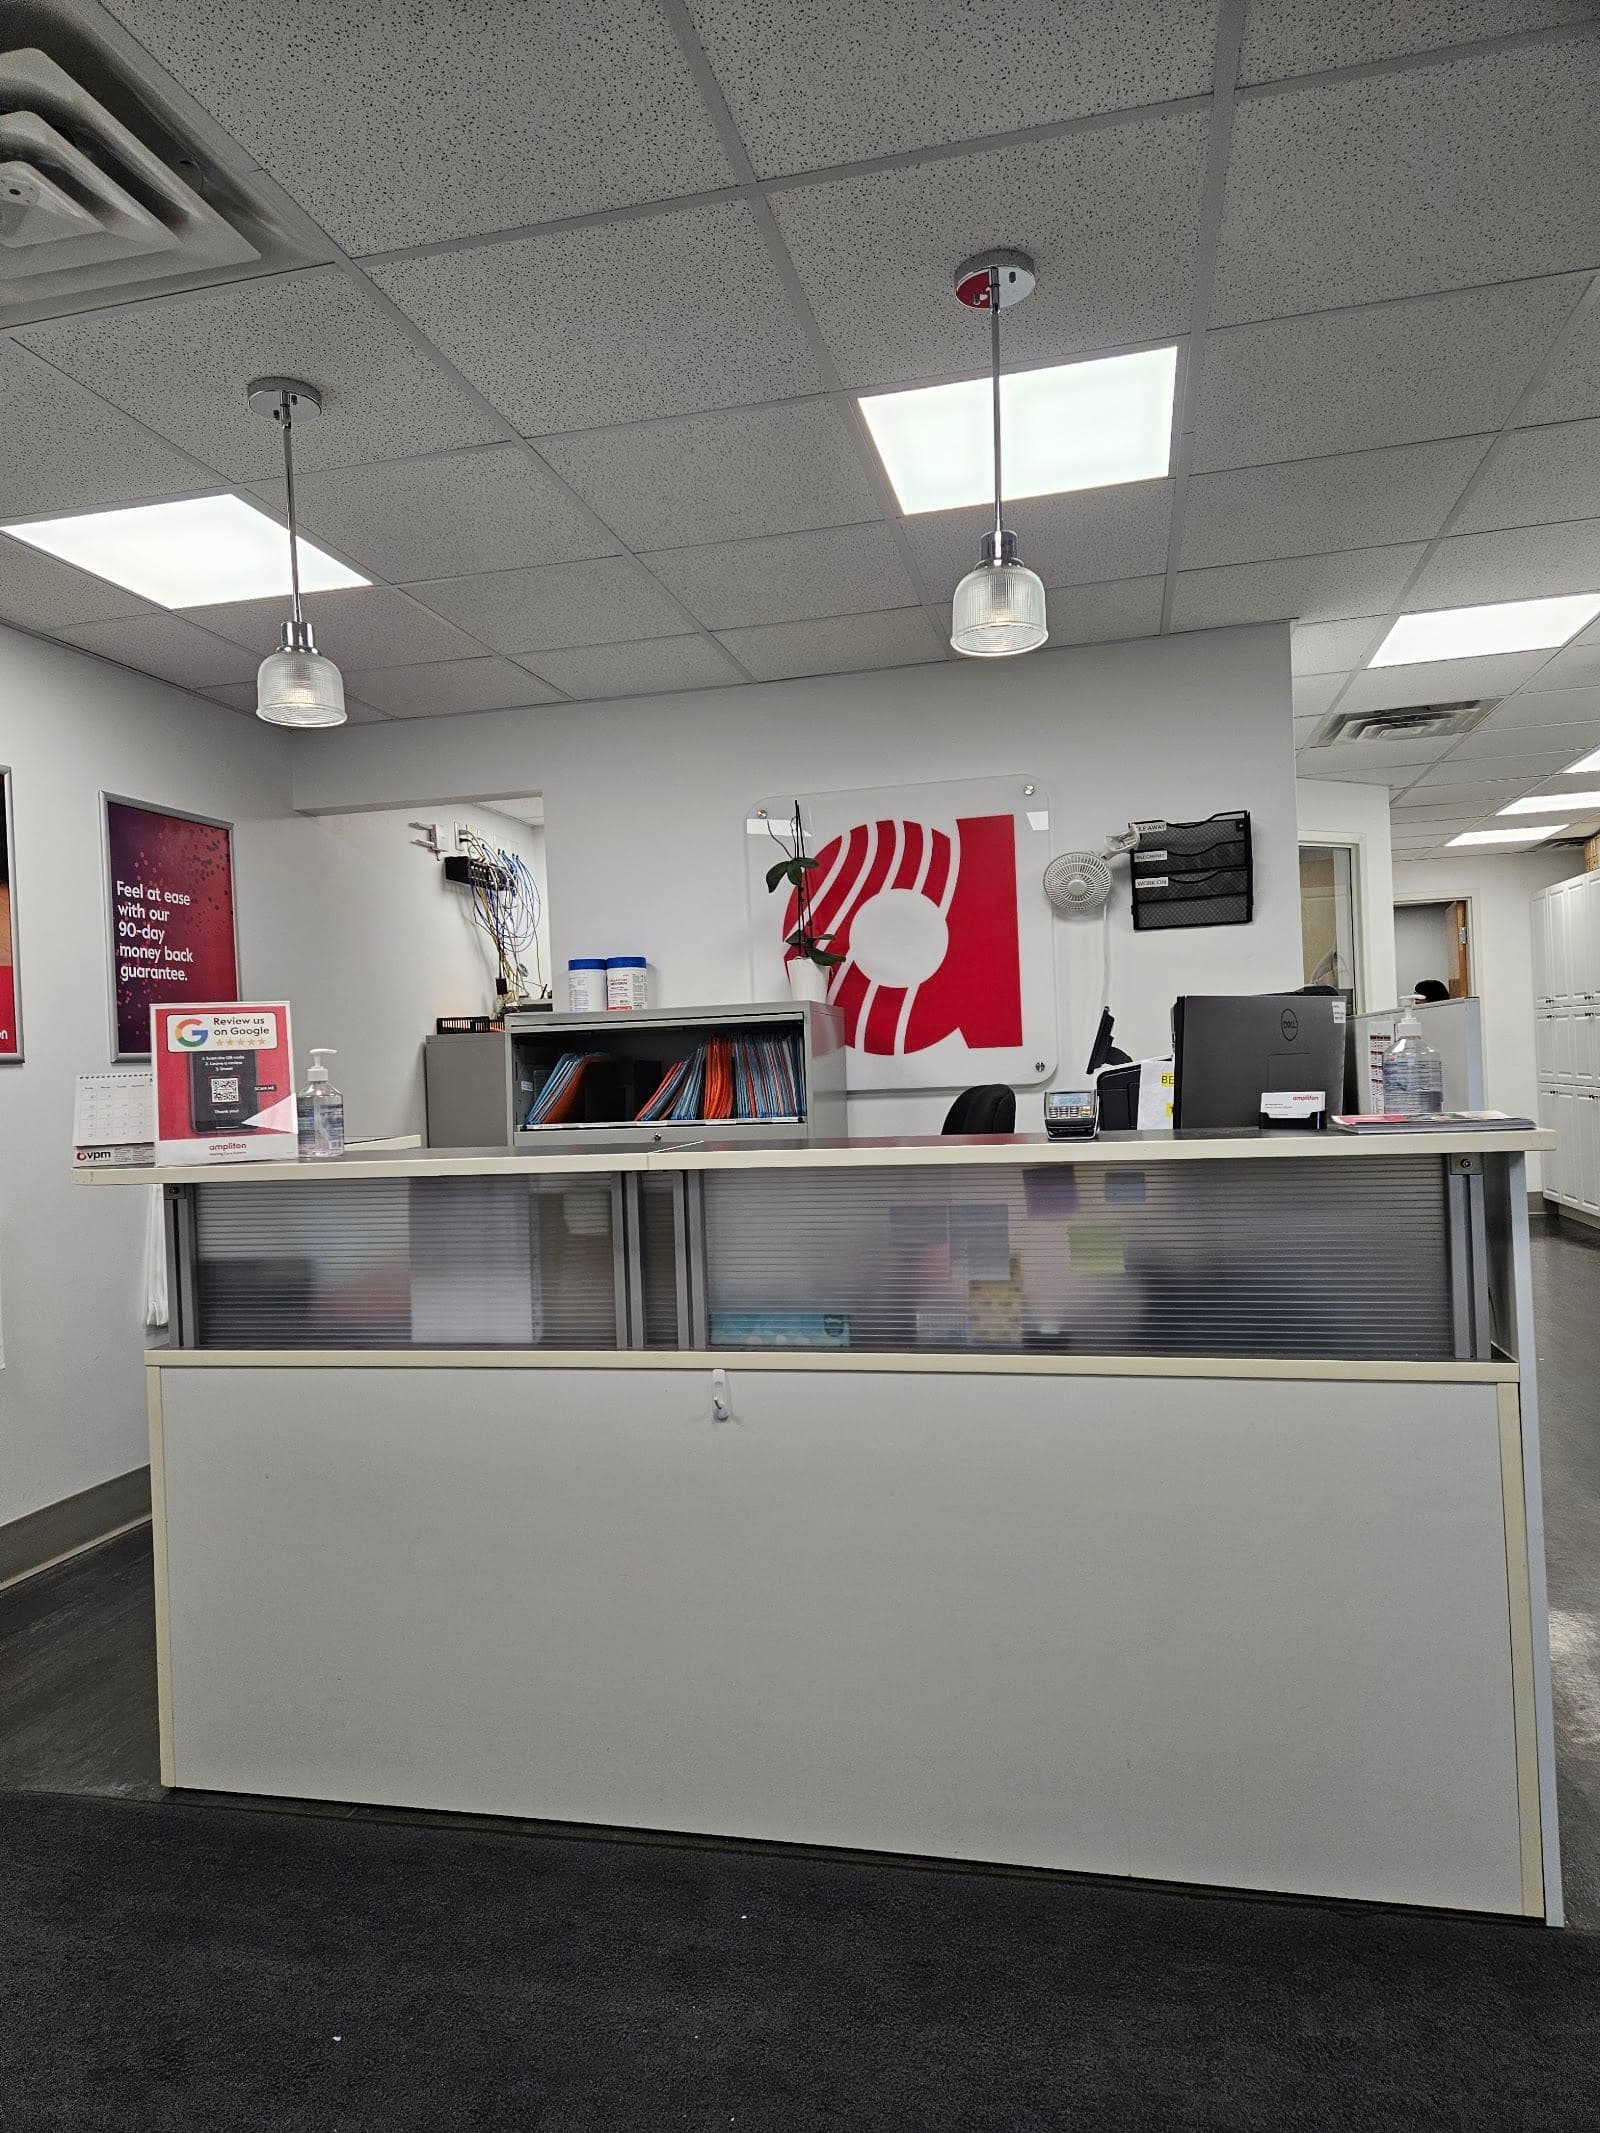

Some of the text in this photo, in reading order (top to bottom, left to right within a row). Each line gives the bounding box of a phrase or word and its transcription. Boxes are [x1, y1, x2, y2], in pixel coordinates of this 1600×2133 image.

[1147, 823, 1166, 831] AWAY
[116, 880, 191, 906] Feel at ease
[117, 902, 170, 922] with our
[118, 920, 165, 944] 90-day
[119, 944, 194, 964] money back
[120, 965, 188, 981] guarantee.
[213, 1016, 265, 1026] Review us
[1283, 1020, 1297, 1029] DELL
[213, 1026, 270, 1037] on Google
[208, 1141, 247, 1152] amplifon
[86, 1150, 112, 1161] vpm
